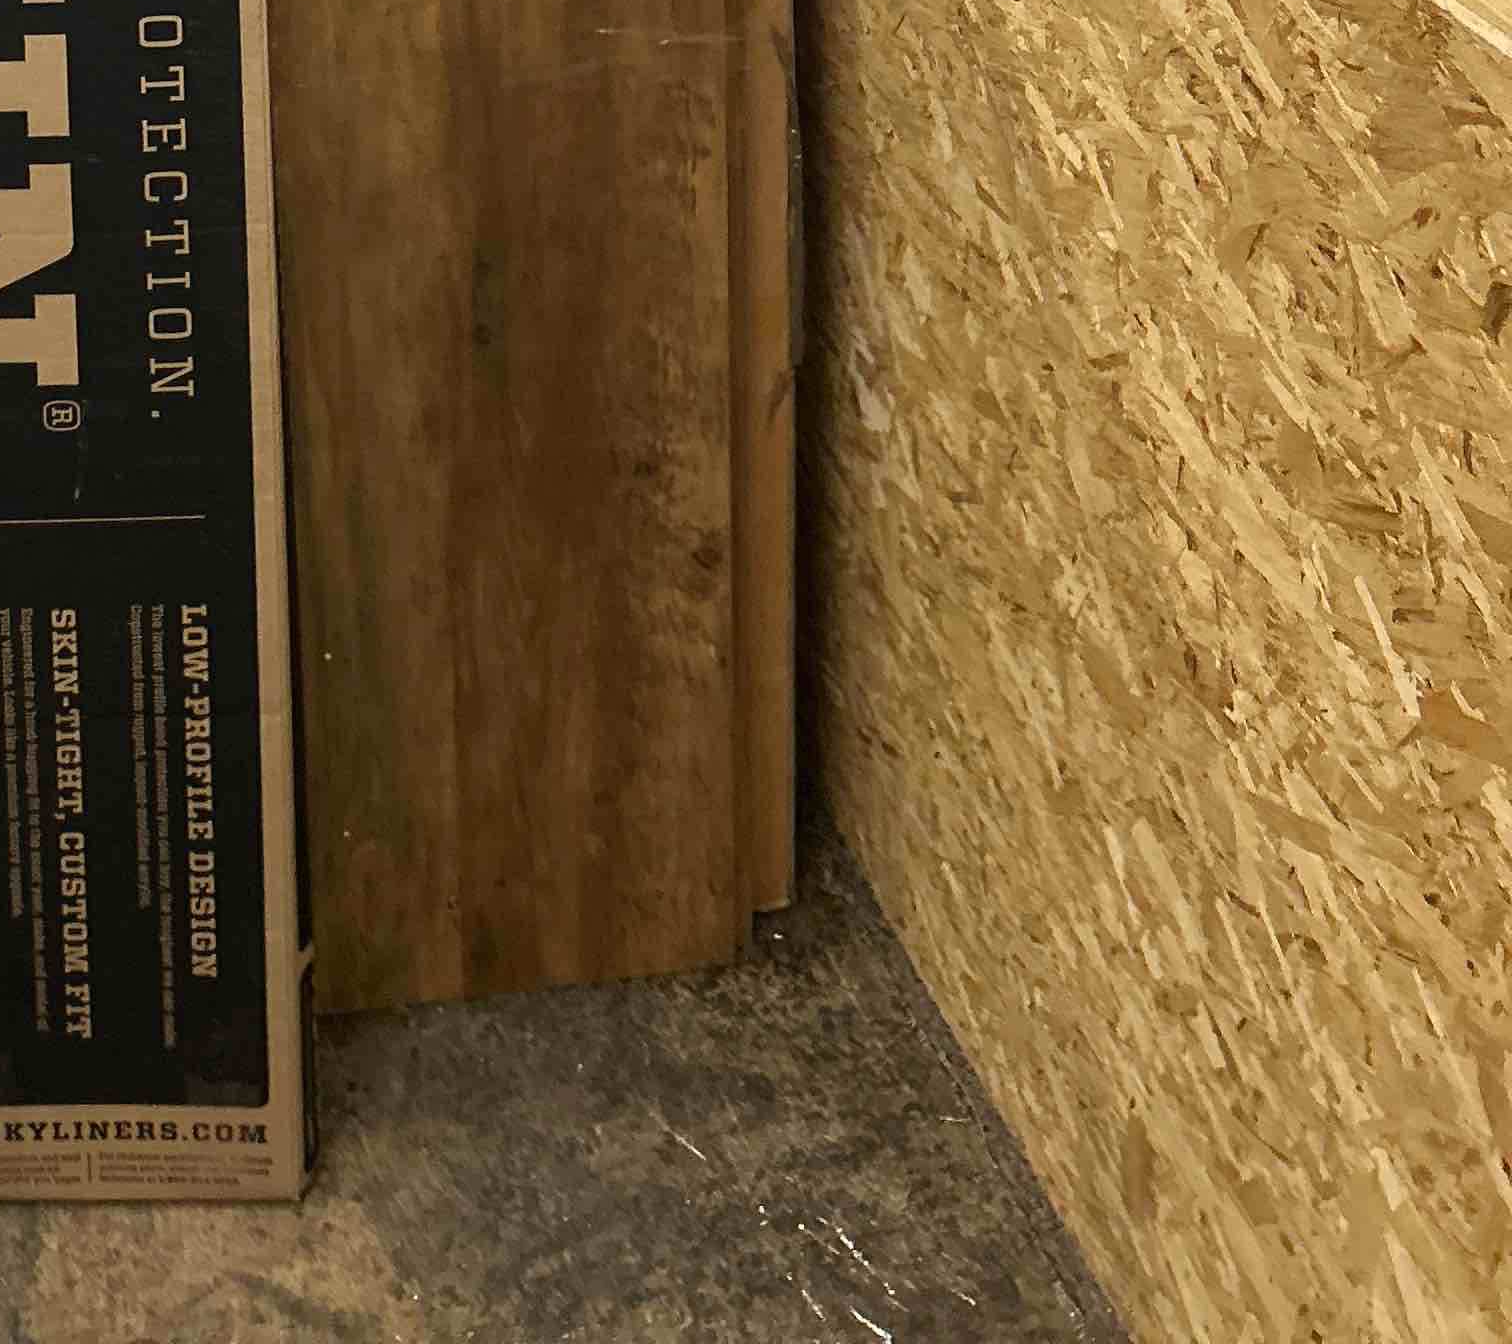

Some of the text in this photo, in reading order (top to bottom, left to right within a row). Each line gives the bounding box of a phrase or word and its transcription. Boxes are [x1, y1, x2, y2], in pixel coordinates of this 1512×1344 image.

[50, 608, 93, 1040] SKIN-TIGHT, CUSTOM FIT
[180, 603, 218, 979] LOW-PROFILE DESIGN
